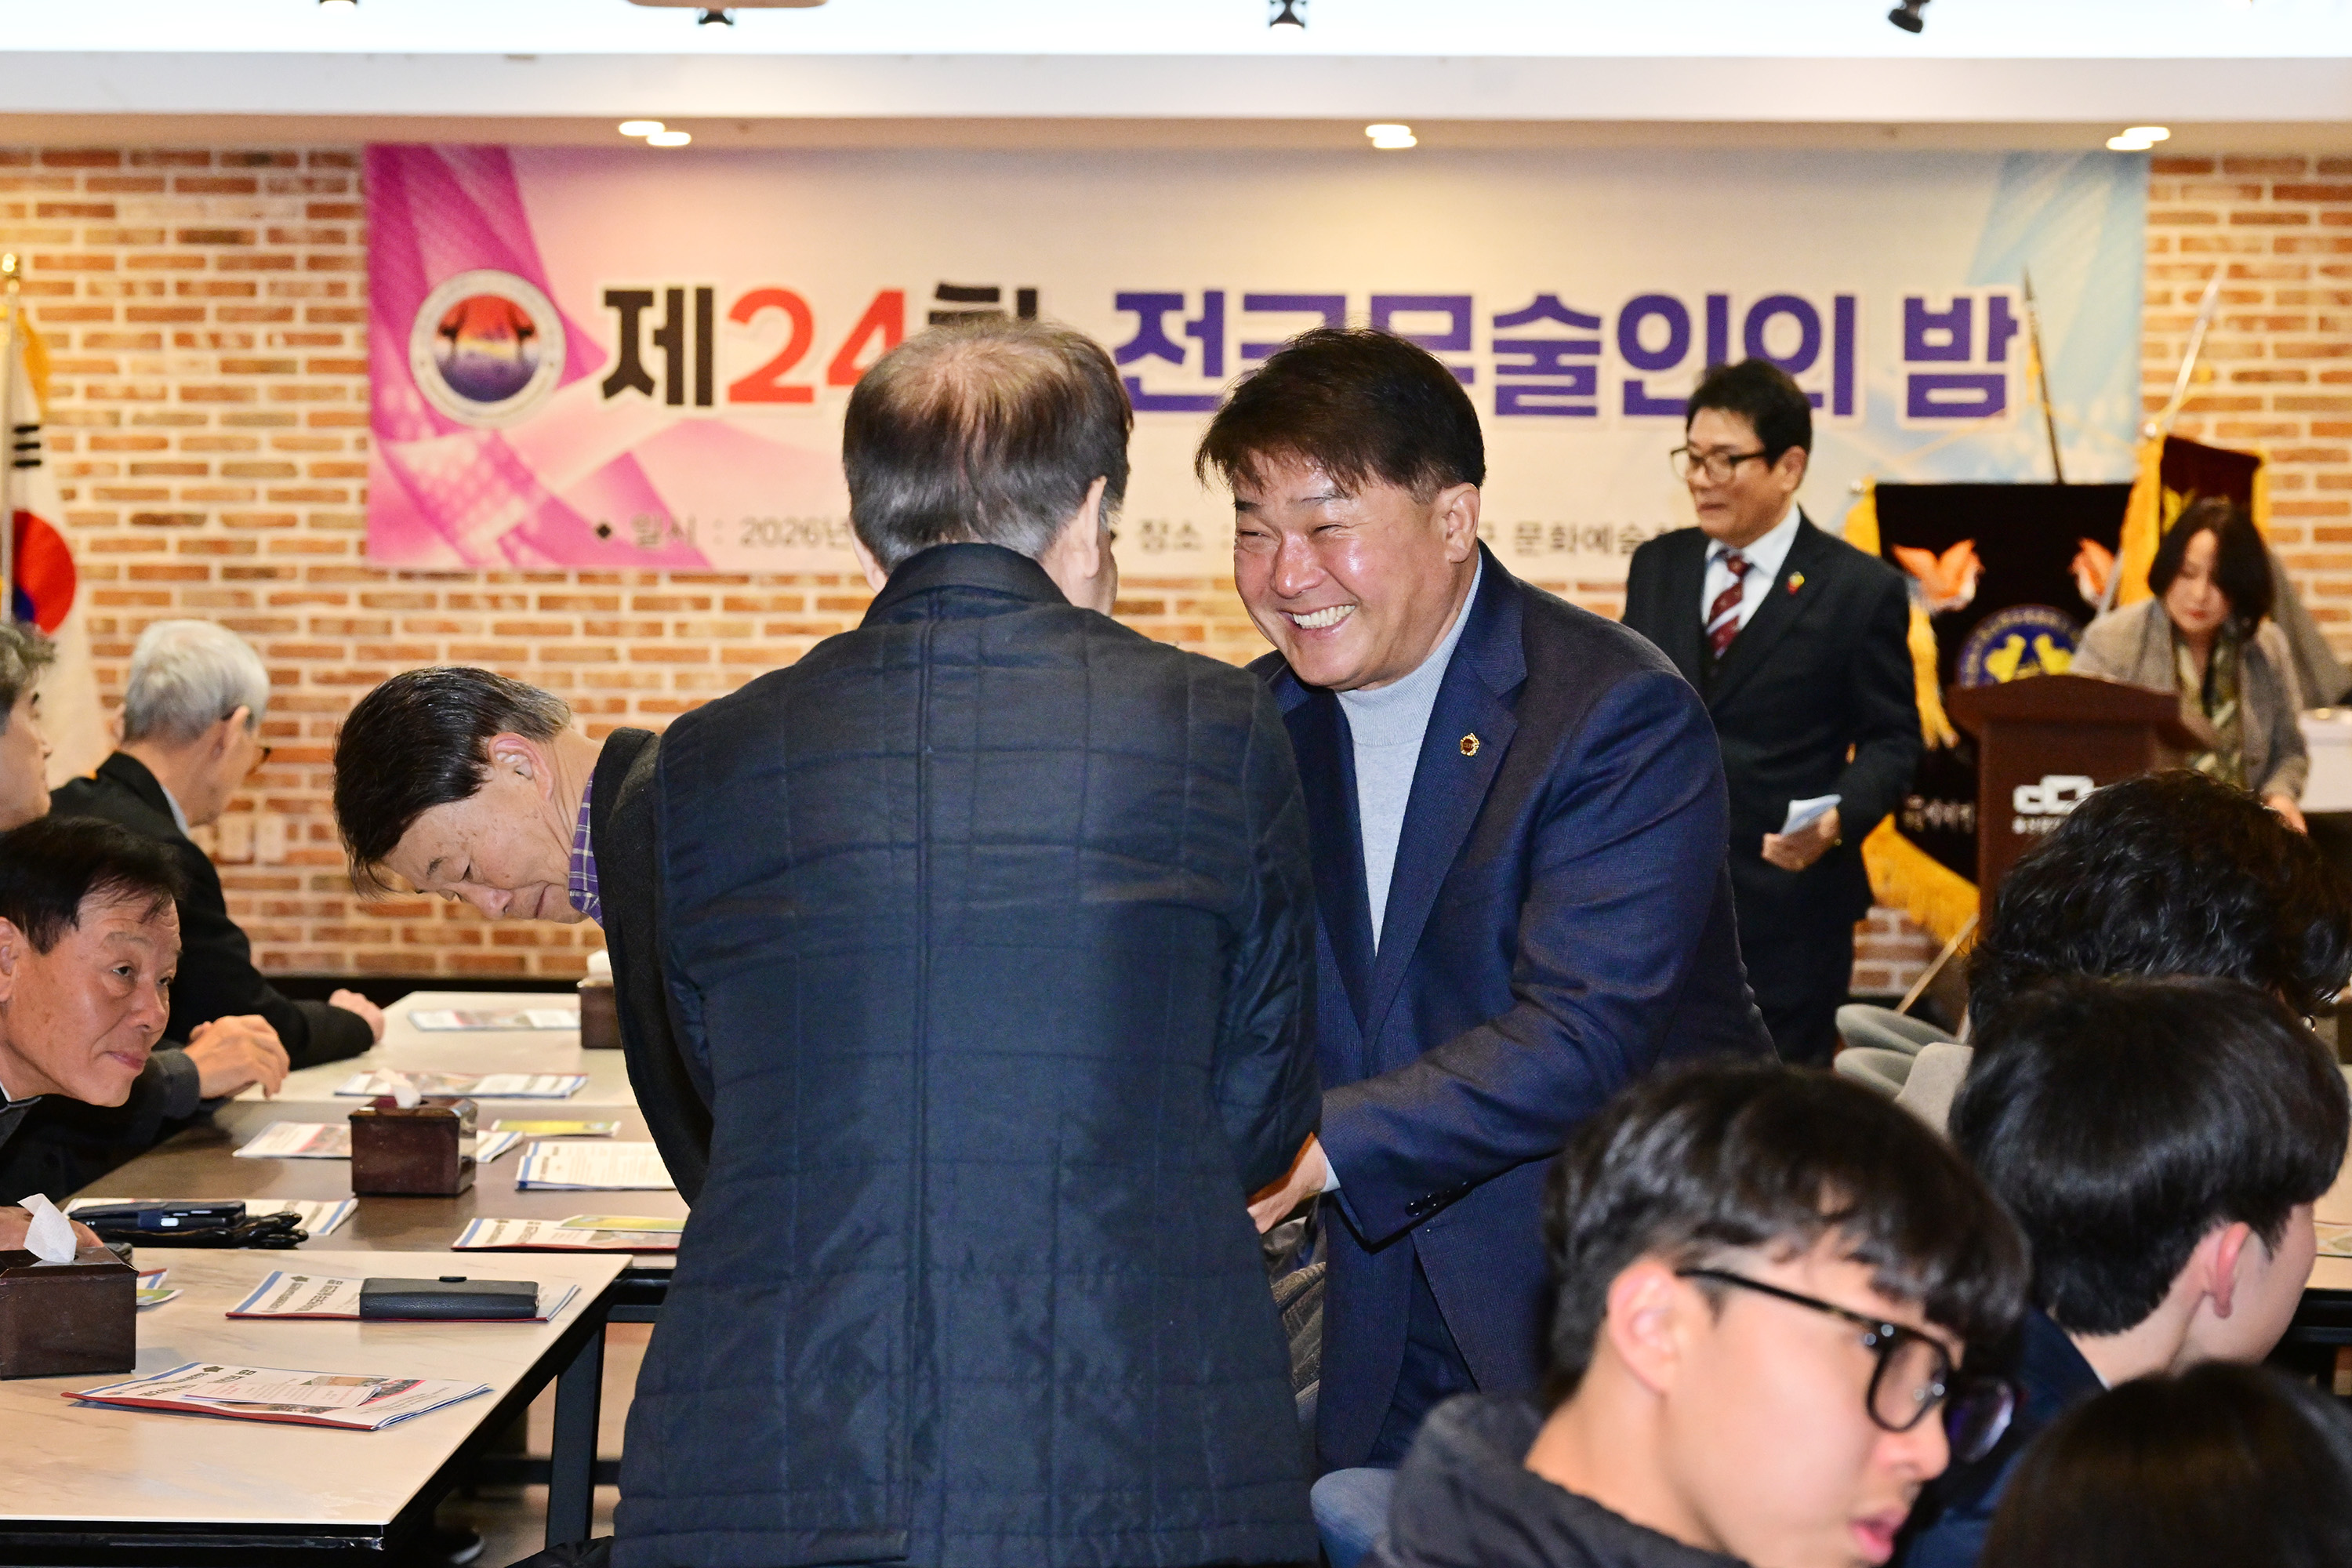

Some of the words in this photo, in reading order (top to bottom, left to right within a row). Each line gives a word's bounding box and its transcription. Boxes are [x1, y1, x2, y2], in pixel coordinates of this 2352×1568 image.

[1904, 295, 2019, 418] 밤
[632, 514, 697, 546] 일시
[1514, 521, 1670, 556] 문화예술
